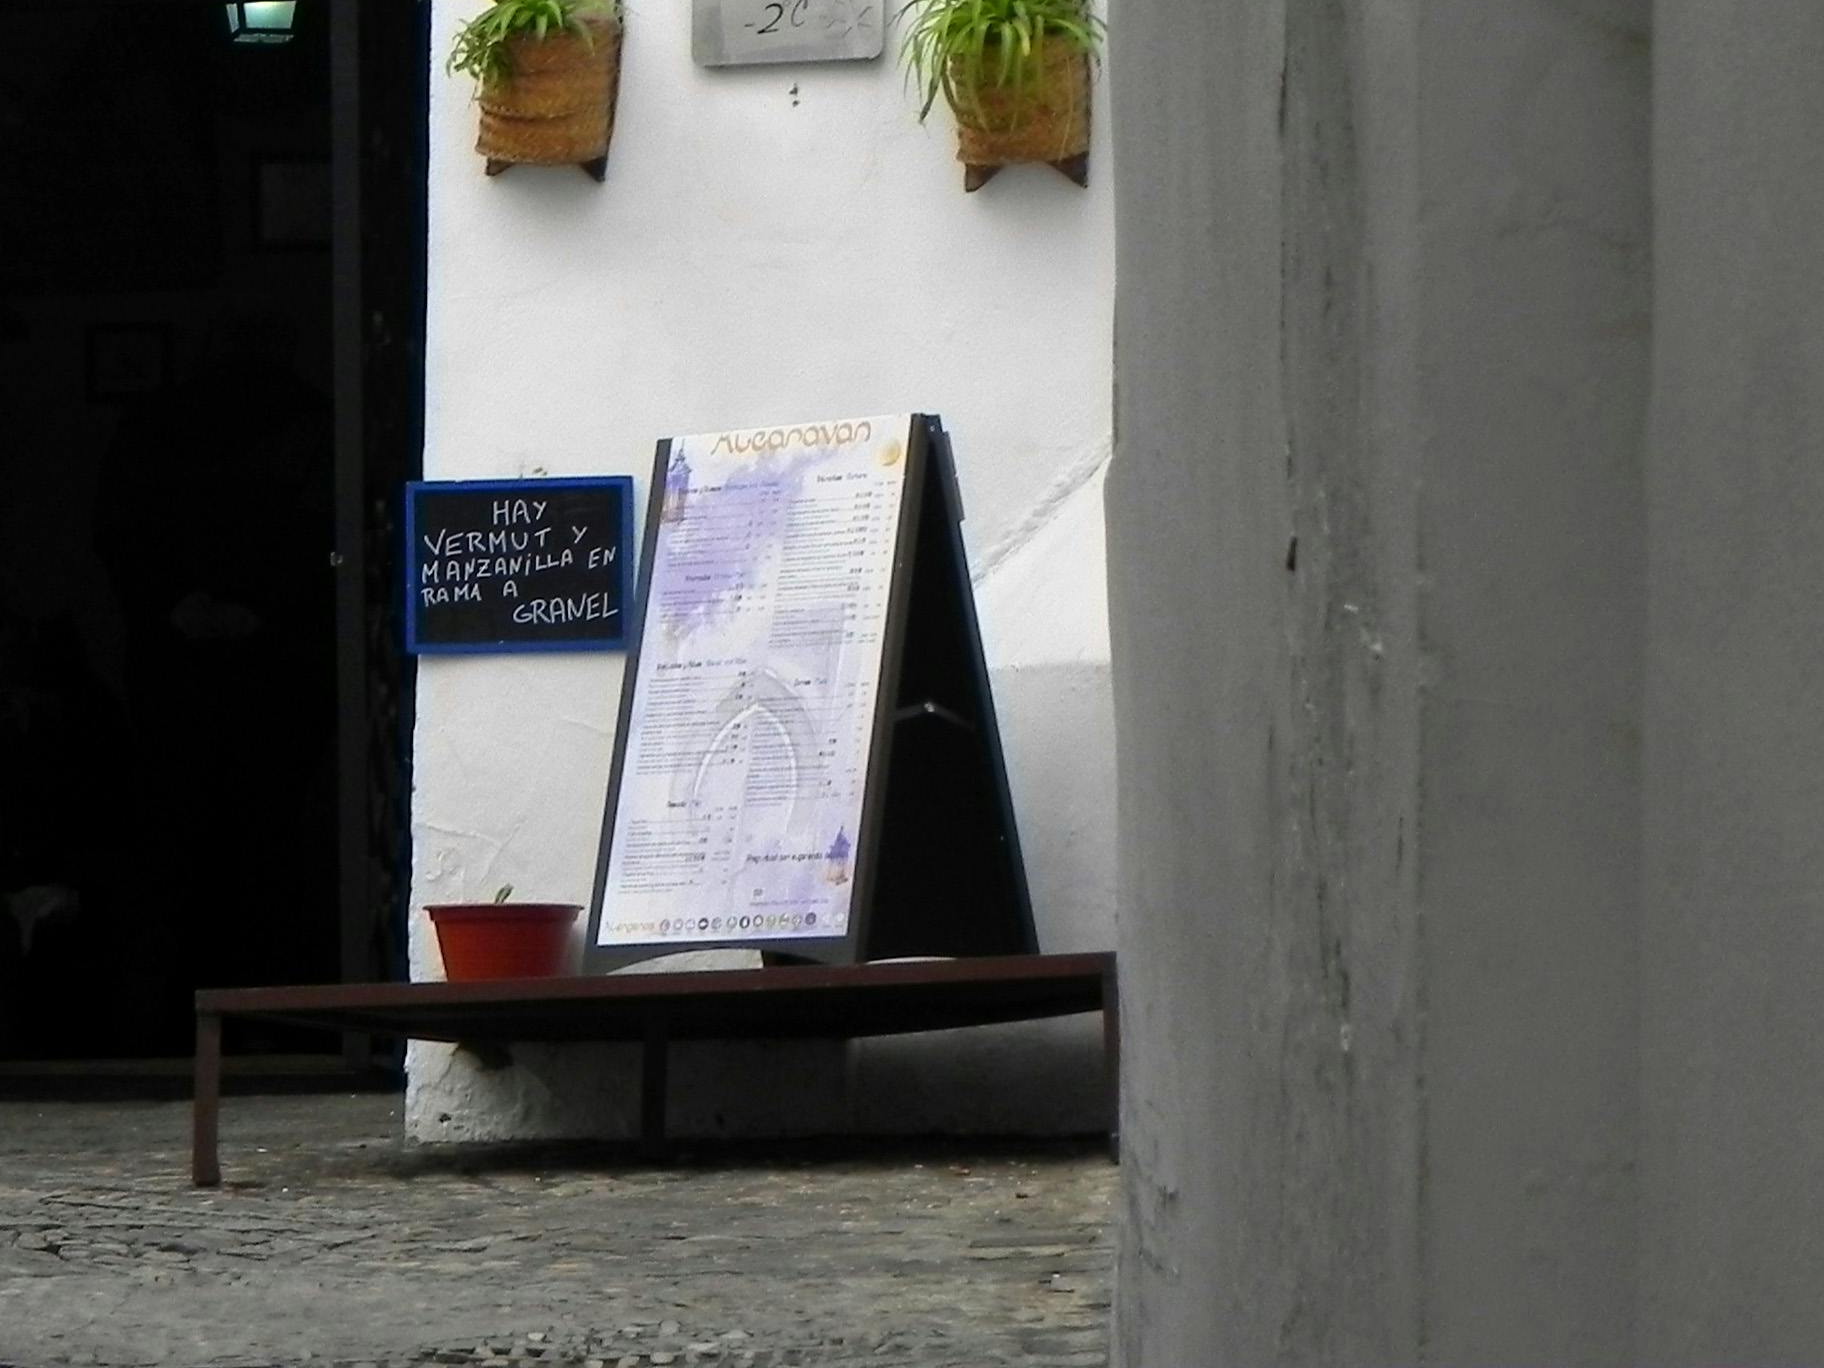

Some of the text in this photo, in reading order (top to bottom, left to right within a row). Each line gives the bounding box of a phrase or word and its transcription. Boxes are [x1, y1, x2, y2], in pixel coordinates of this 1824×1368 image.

[492, 499, 548, 526] HAY
[423, 526, 588, 557] VERMUT Y
[587, 546, 617, 570] EN
[421, 580, 519, 608] RAMA A
[512, 592, 619, 625] GRANEL
